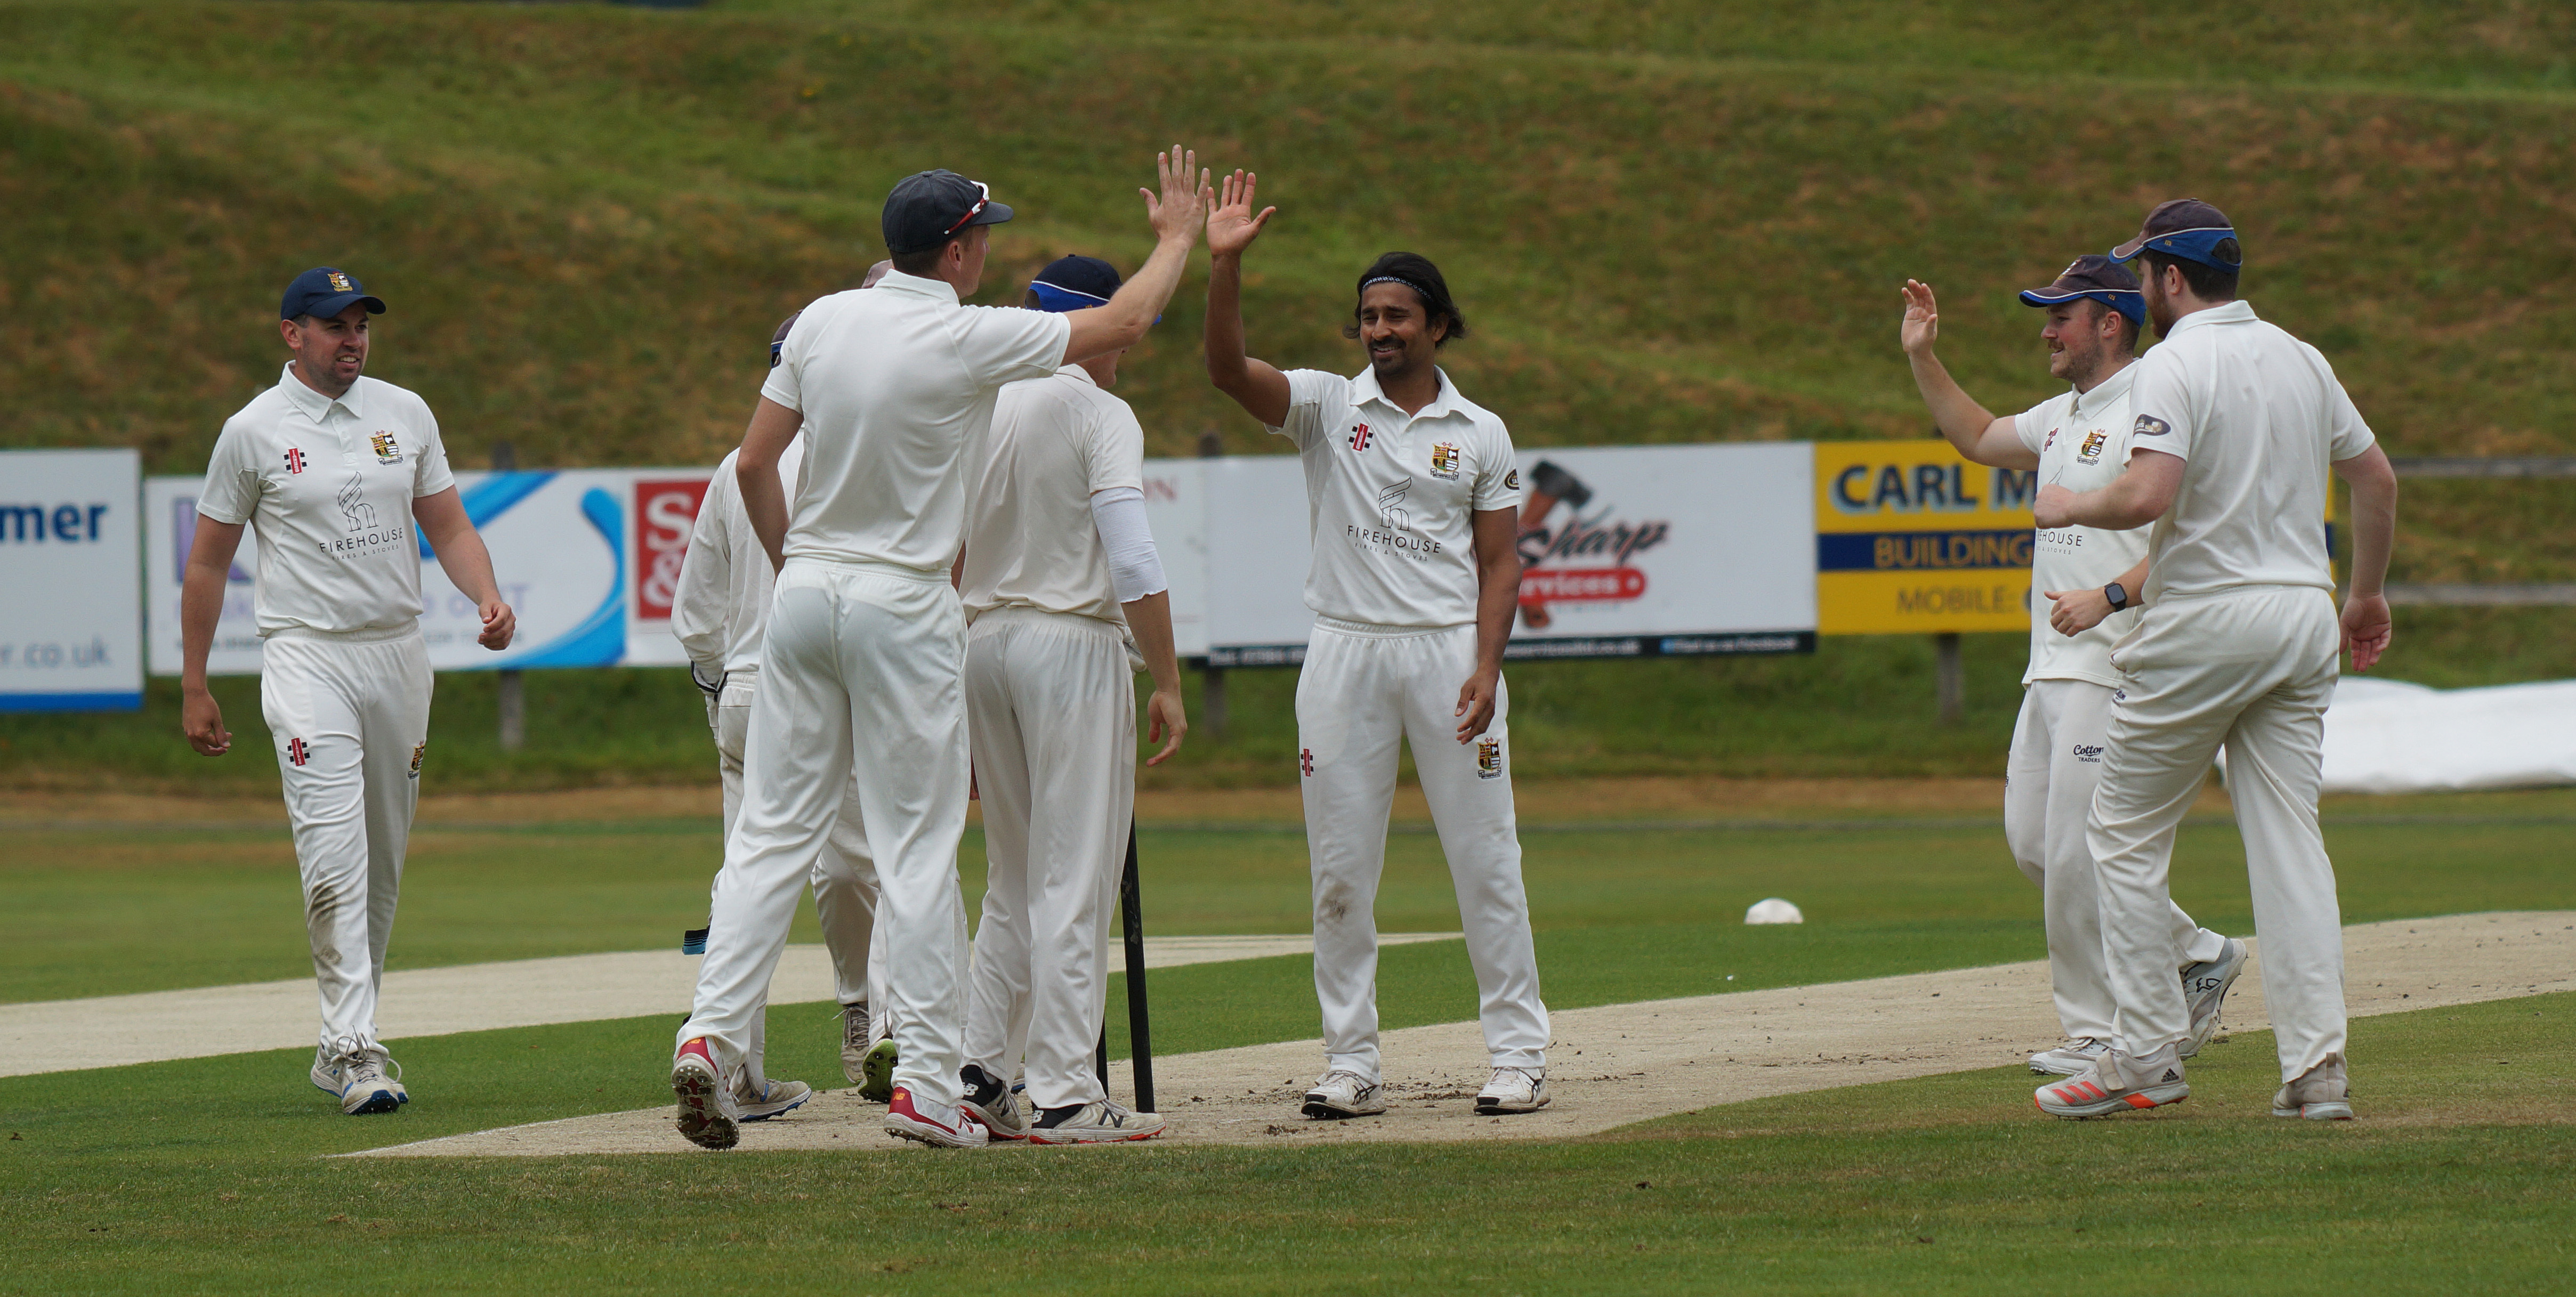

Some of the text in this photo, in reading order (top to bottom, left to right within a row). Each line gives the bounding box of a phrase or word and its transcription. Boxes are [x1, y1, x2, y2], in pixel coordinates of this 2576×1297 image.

[1829, 463, 1981, 516] CARL
[645, 491, 693, 553] S
[319, 528, 402, 553] FIREHOUSE
[372, 544, 399, 555] STOVES
[1347, 524, 1441, 554] FIREHOUSE
[1355, 542, 1377, 552] FIRES
[1394, 551, 1427, 562] STOVES
[1517, 513, 1667, 568] Sharp
[1874, 535, 2033, 568] BUILDING
